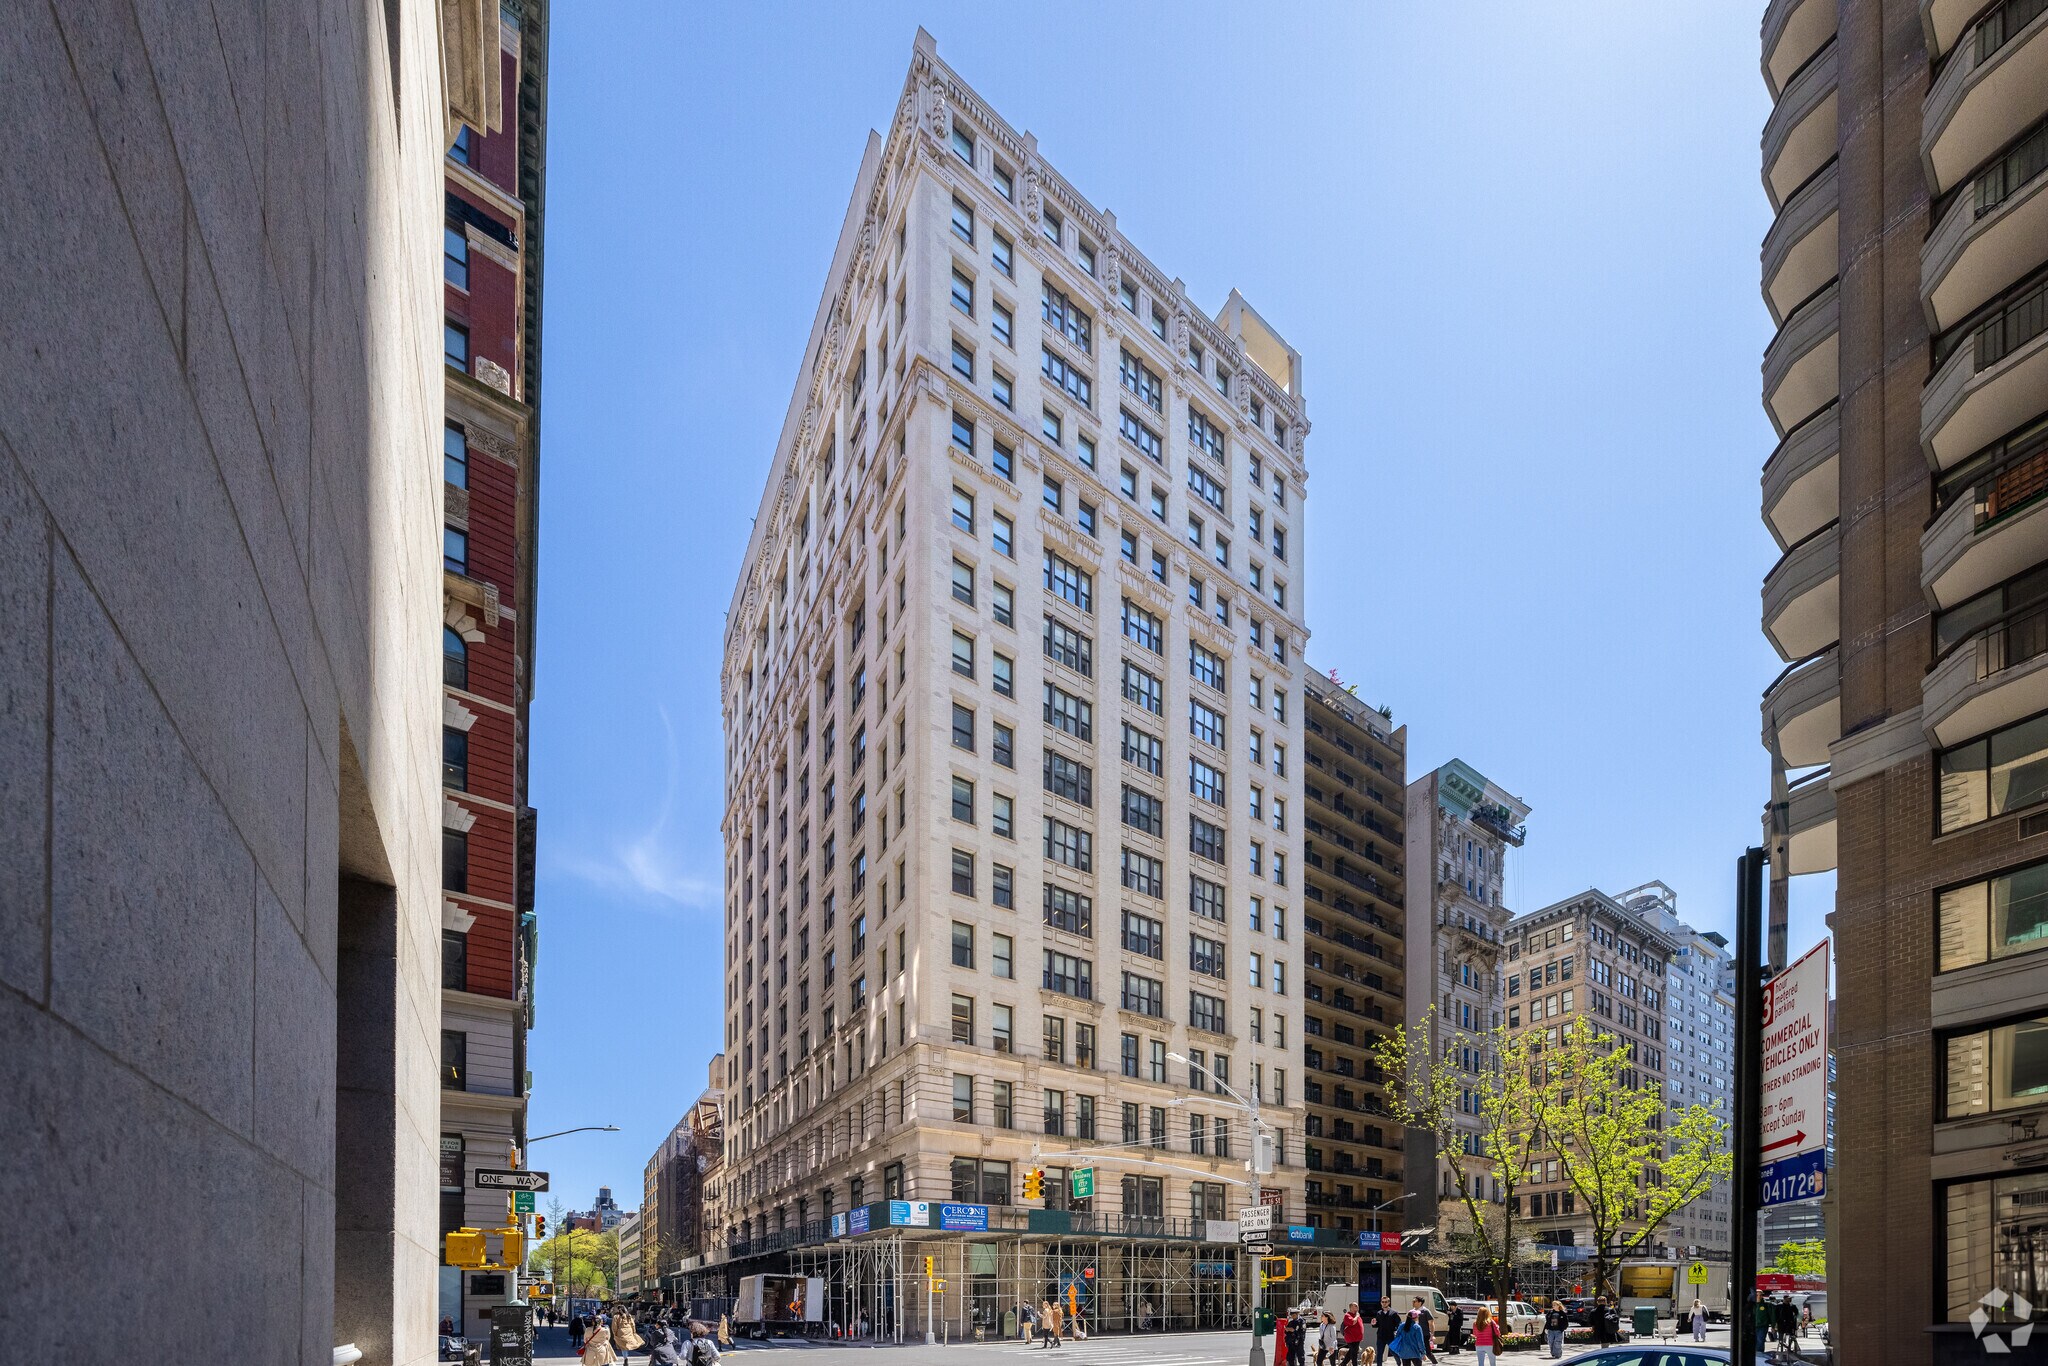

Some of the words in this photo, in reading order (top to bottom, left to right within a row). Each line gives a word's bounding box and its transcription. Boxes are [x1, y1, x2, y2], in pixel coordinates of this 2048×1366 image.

[1775, 978, 1788, 993] hour
[1775, 981, 1799, 1006] metered
[1762, 988, 1772, 1025] 3
[1775, 998, 1795, 1020] parking
[1761, 1013, 1812, 1055] COMMERCIAL
[1761, 1042, 1797, 1074] VEHICLES
[1799, 1028, 1820, 1054] ONLY
[1782, 1072, 1791, 1086] NO
[1792, 1057, 1821, 1082] STANDING
[1778, 1097, 1794, 1112] 6pm
[1781, 1109, 1806, 1128] Sunday
[481, 1174, 503, 1183] ONE
[515, 1176, 539, 1186] WAY
[942, 1206, 986, 1217] CERCONE
[1241, 1208, 1270, 1218] PASSENGER
[1241, 1220, 1255, 1228] CARS
[1256, 1218, 1270, 1227] ONLY
[1290, 1231, 1313, 1240] citibank
